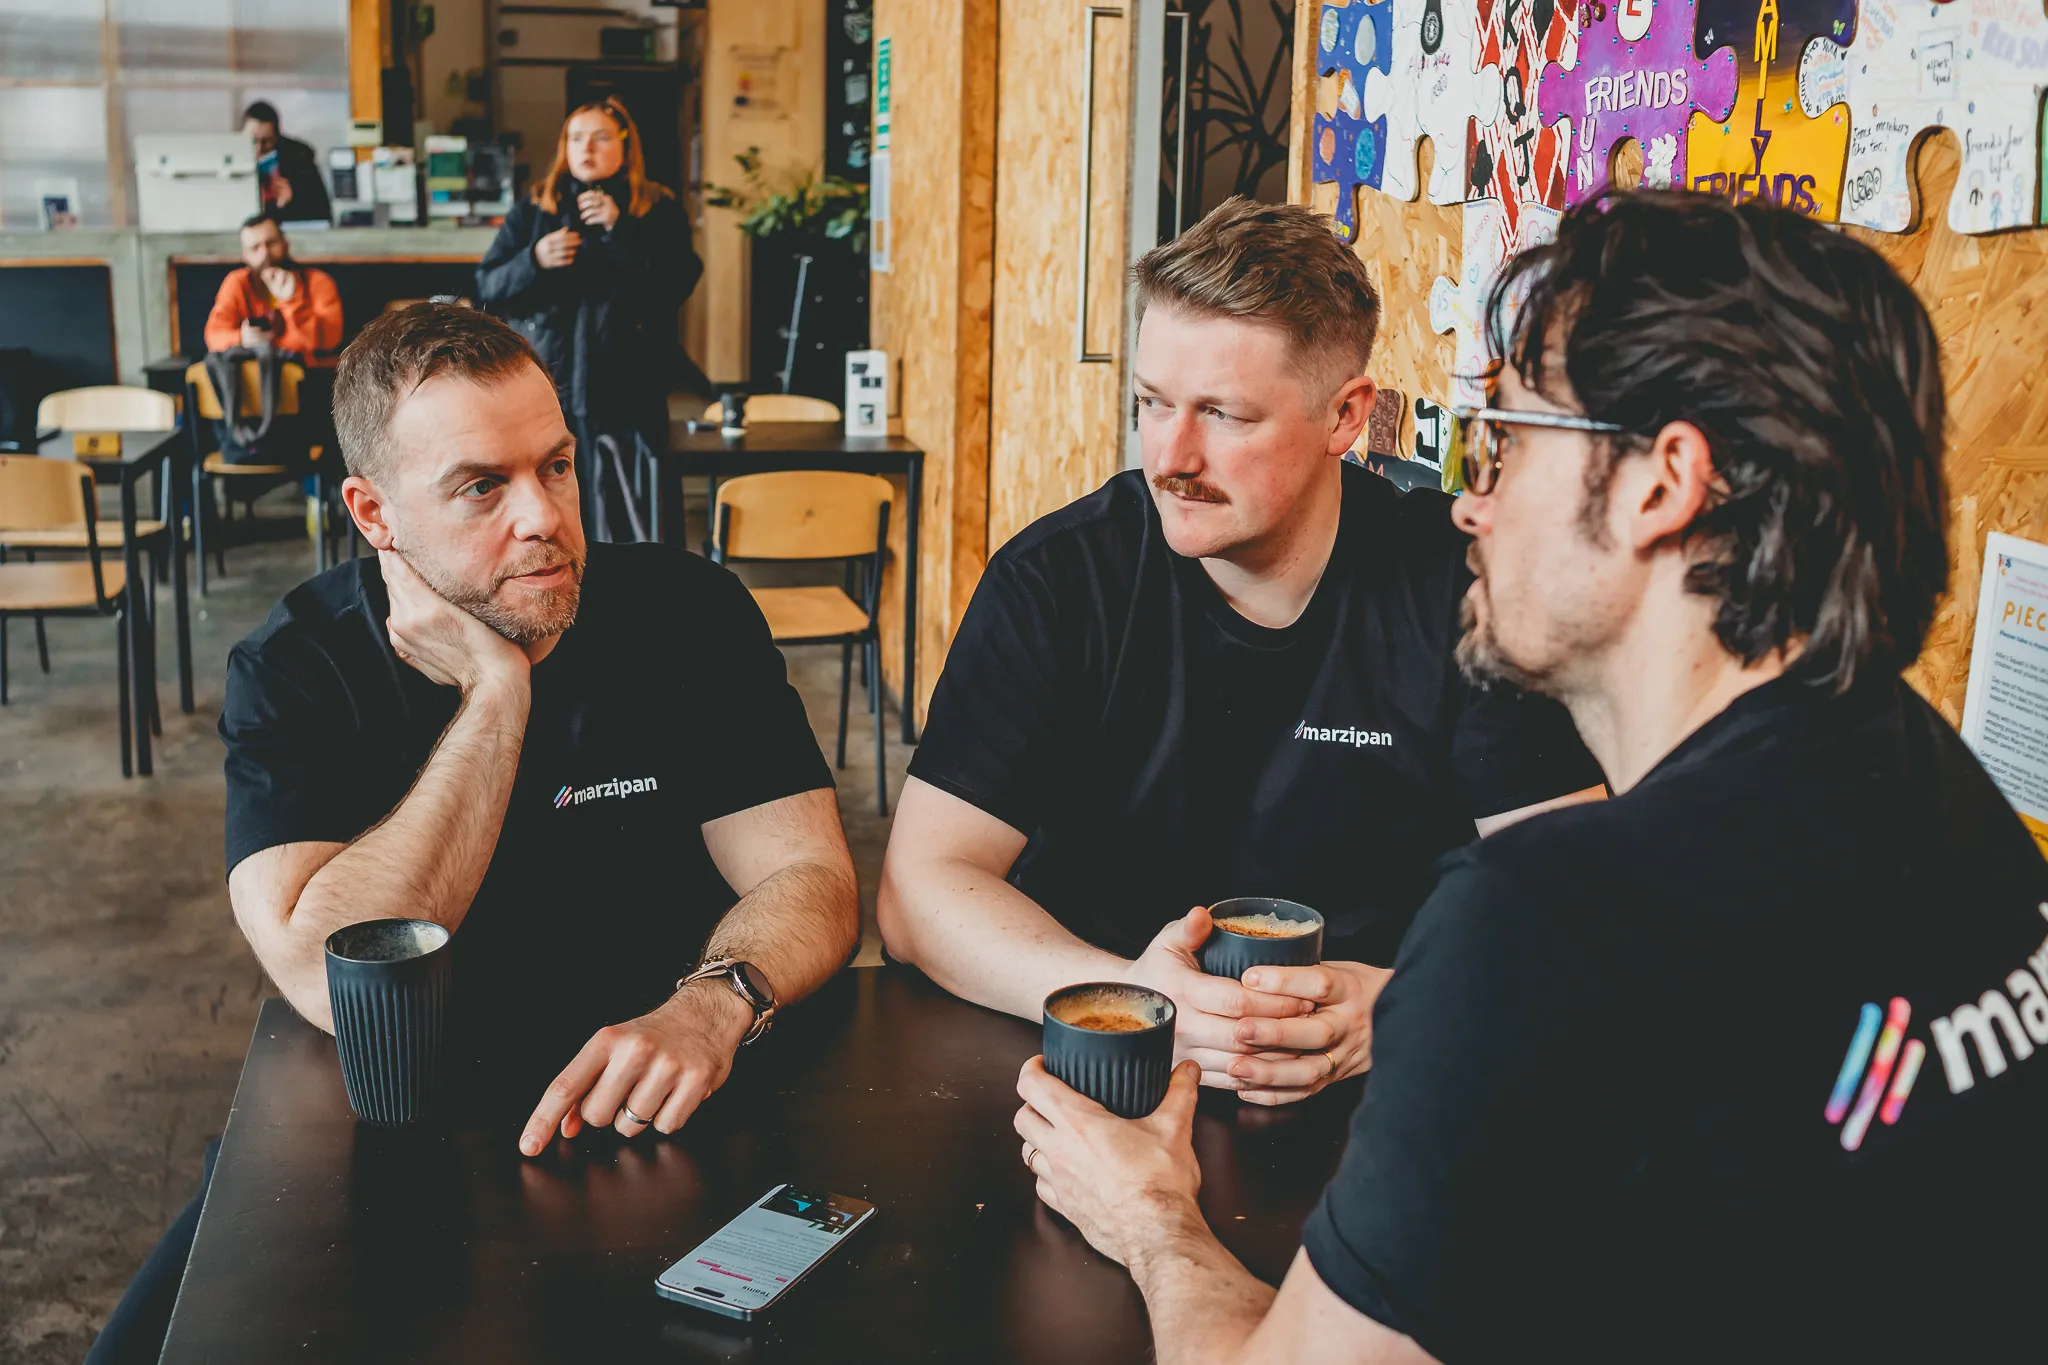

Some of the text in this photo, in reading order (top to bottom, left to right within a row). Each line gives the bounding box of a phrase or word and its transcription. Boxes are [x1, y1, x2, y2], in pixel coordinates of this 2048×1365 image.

[1585, 68, 1688, 116] FRIENDS
[2002, 600, 2048, 631] PIEC
[1303, 726, 1393, 748] marzipan
[574, 777, 658, 805] marzipan
[1930, 902, 2048, 1095] ma
